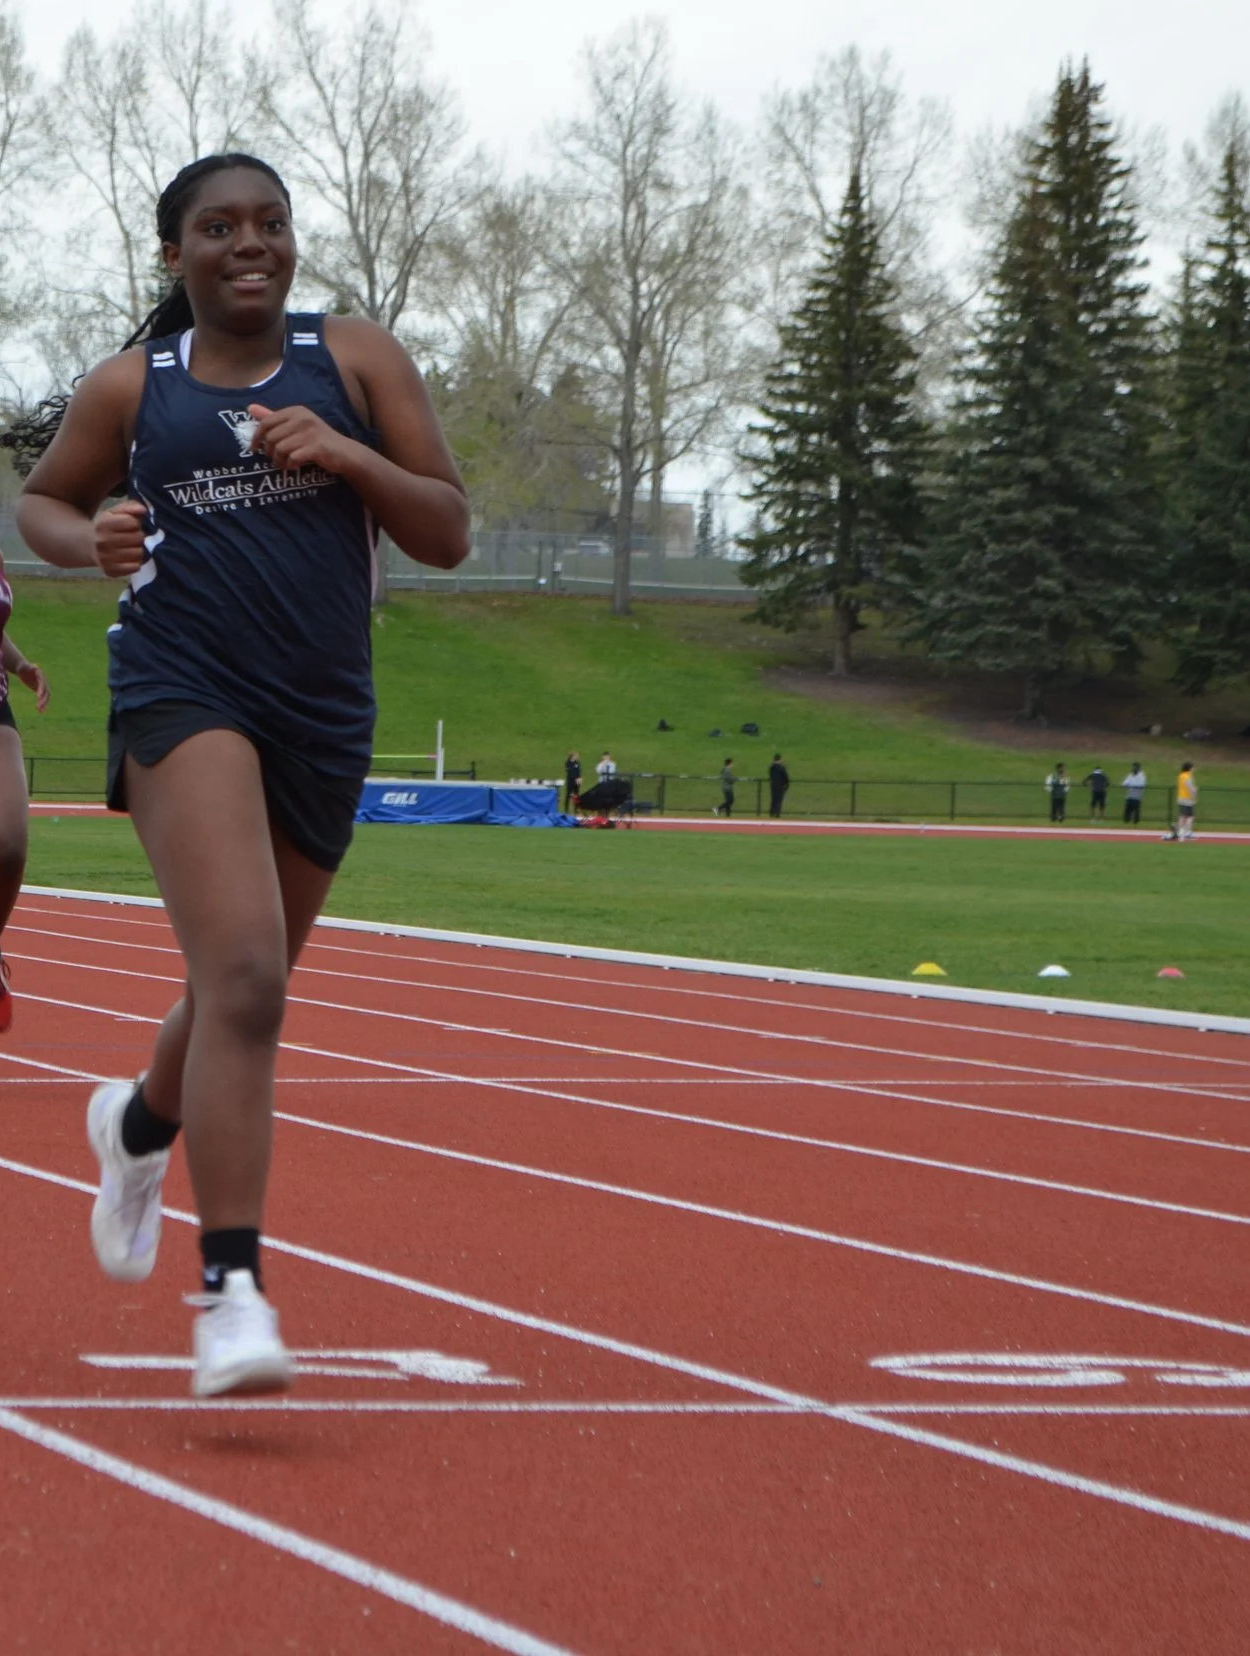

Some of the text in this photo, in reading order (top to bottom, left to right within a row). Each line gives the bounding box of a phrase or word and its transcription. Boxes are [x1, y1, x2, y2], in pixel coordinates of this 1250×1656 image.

[192, 465, 245, 480] Webber
[168, 479, 255, 505] Wildcats
[244, 498, 253, 509] &
[382, 791, 419, 805] GILL
